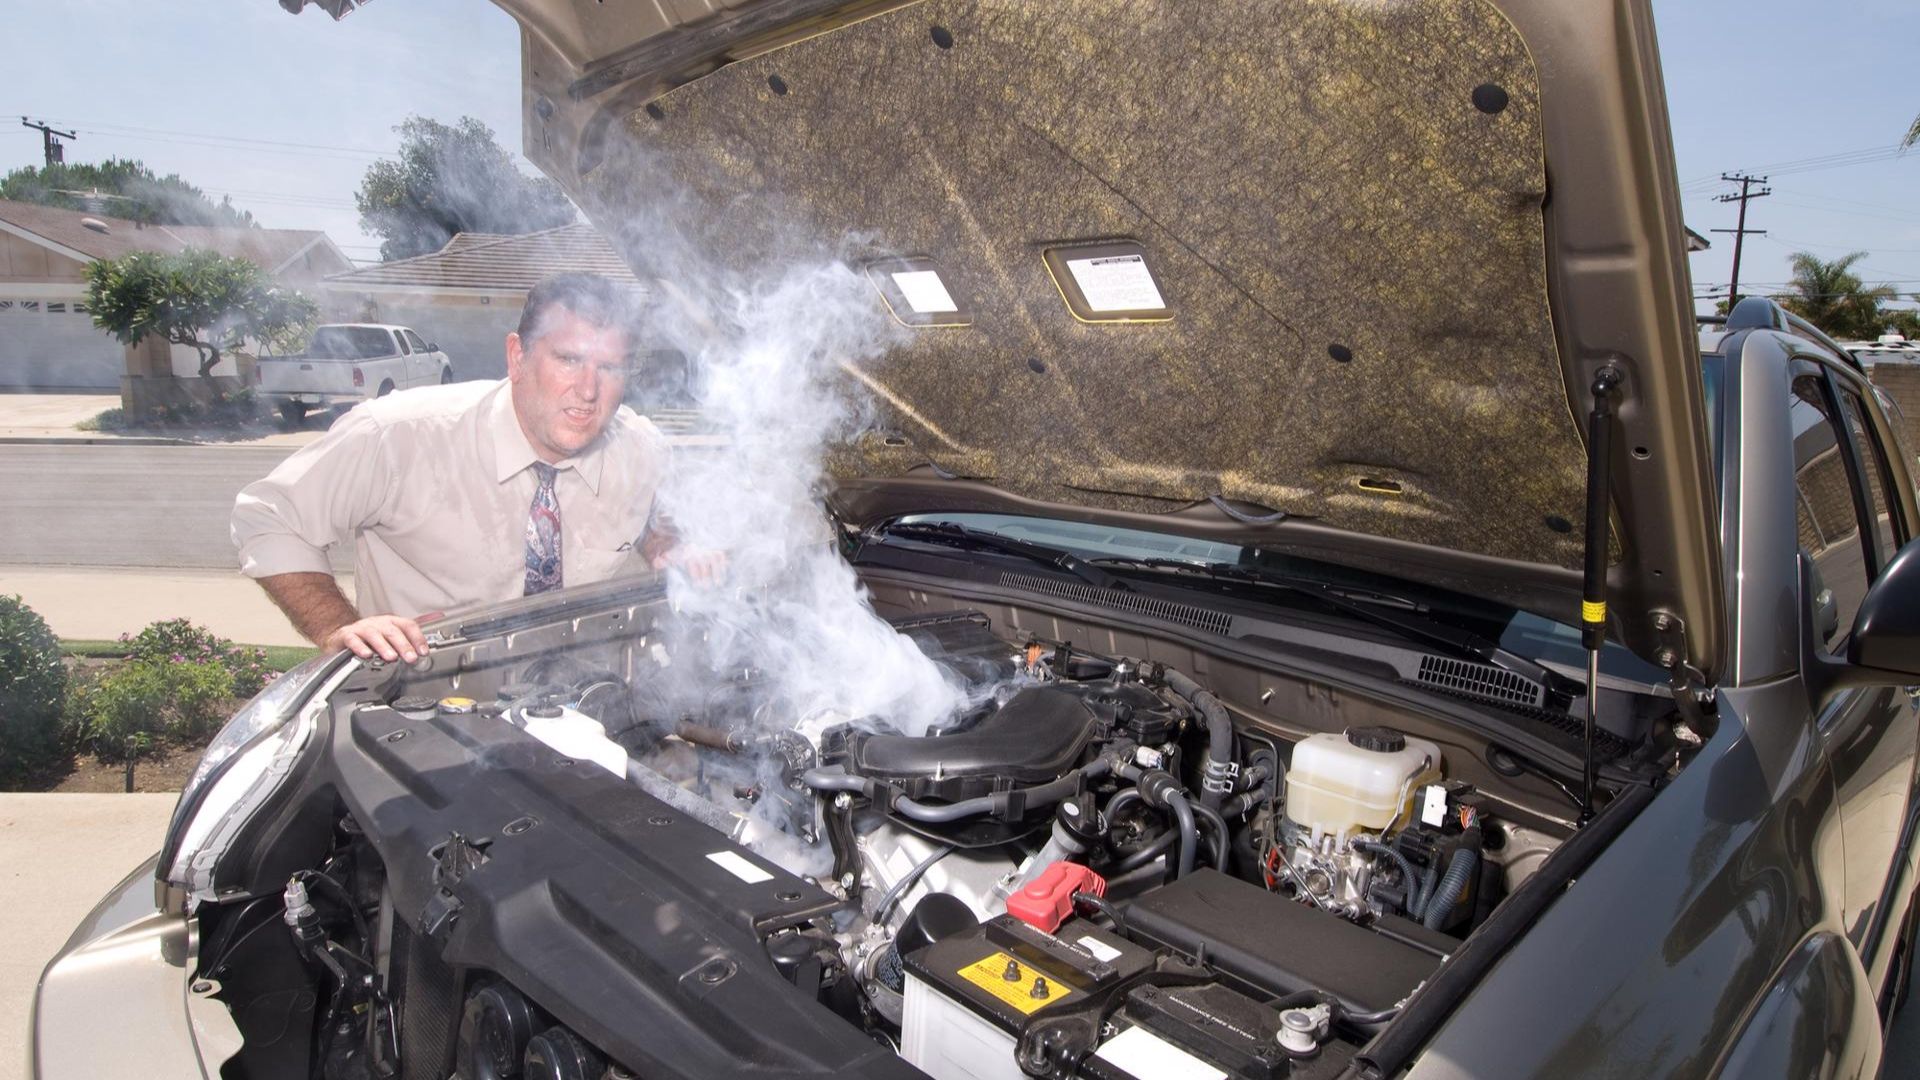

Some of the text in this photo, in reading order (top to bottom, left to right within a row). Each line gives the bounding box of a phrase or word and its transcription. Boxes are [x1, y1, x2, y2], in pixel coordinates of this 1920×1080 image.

[1169, 996, 1256, 1040] MAINTENANCE FREE BATTERY
